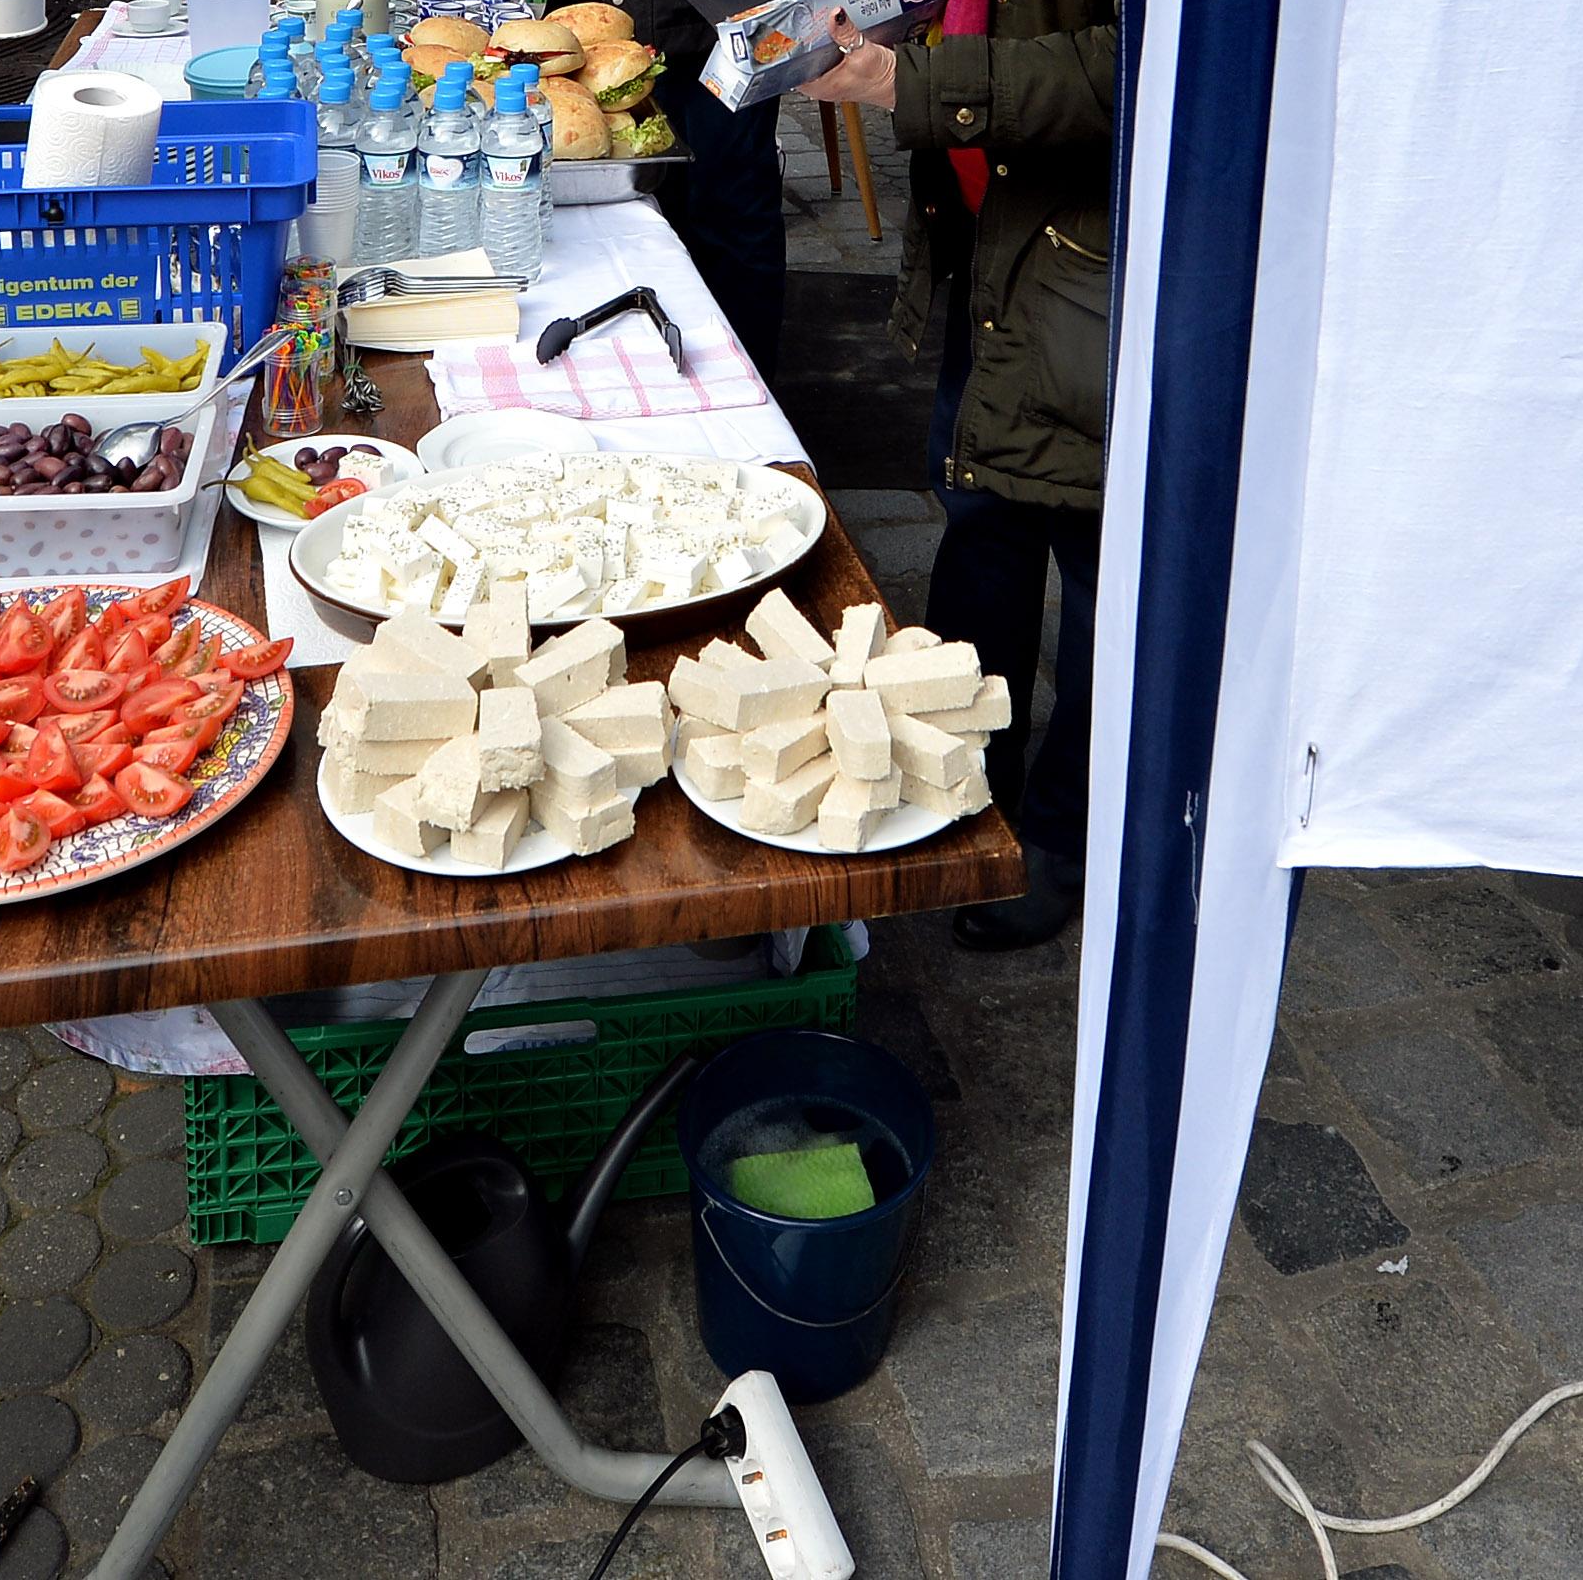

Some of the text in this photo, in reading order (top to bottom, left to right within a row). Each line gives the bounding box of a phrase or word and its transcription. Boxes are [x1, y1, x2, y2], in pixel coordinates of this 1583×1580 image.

[372, 168, 401, 180] Vikos
[494, 171, 523, 182] Vikos
[100, 273, 139, 288] der
[15, 300, 114, 321] EDEKA
